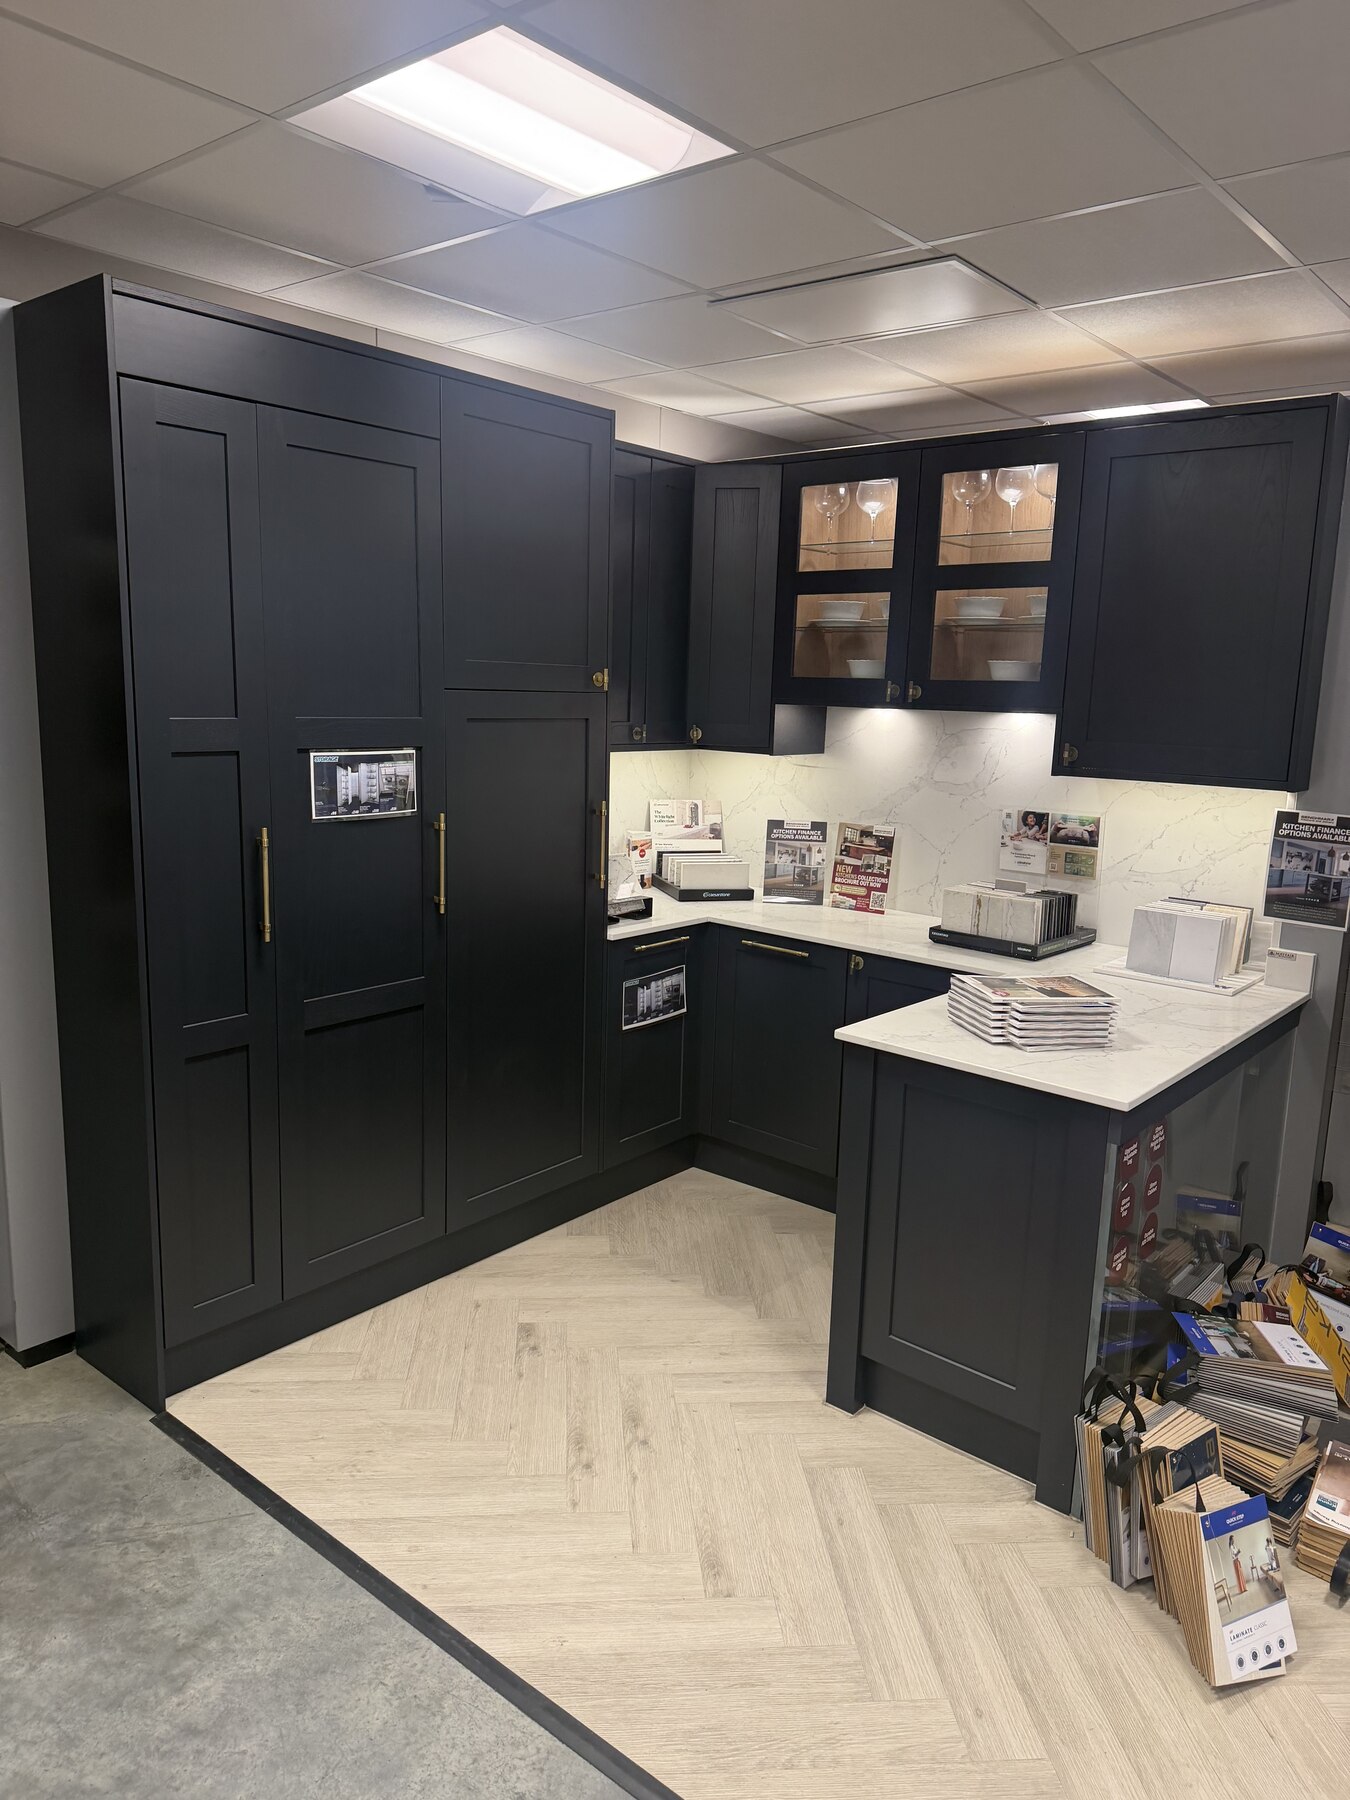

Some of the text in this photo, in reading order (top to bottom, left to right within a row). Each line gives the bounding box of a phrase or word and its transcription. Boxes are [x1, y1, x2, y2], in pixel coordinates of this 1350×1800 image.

[1278, 829, 1312, 839] OPTIONS
[1282, 822, 1350, 836] KITCHEN FINANCE
[836, 864, 854, 874] NEW
[834, 876, 860, 886] BROCHURE
[857, 874, 889, 884] COLLECTIONS
[1229, 1626, 1253, 1642] LAMINATE
